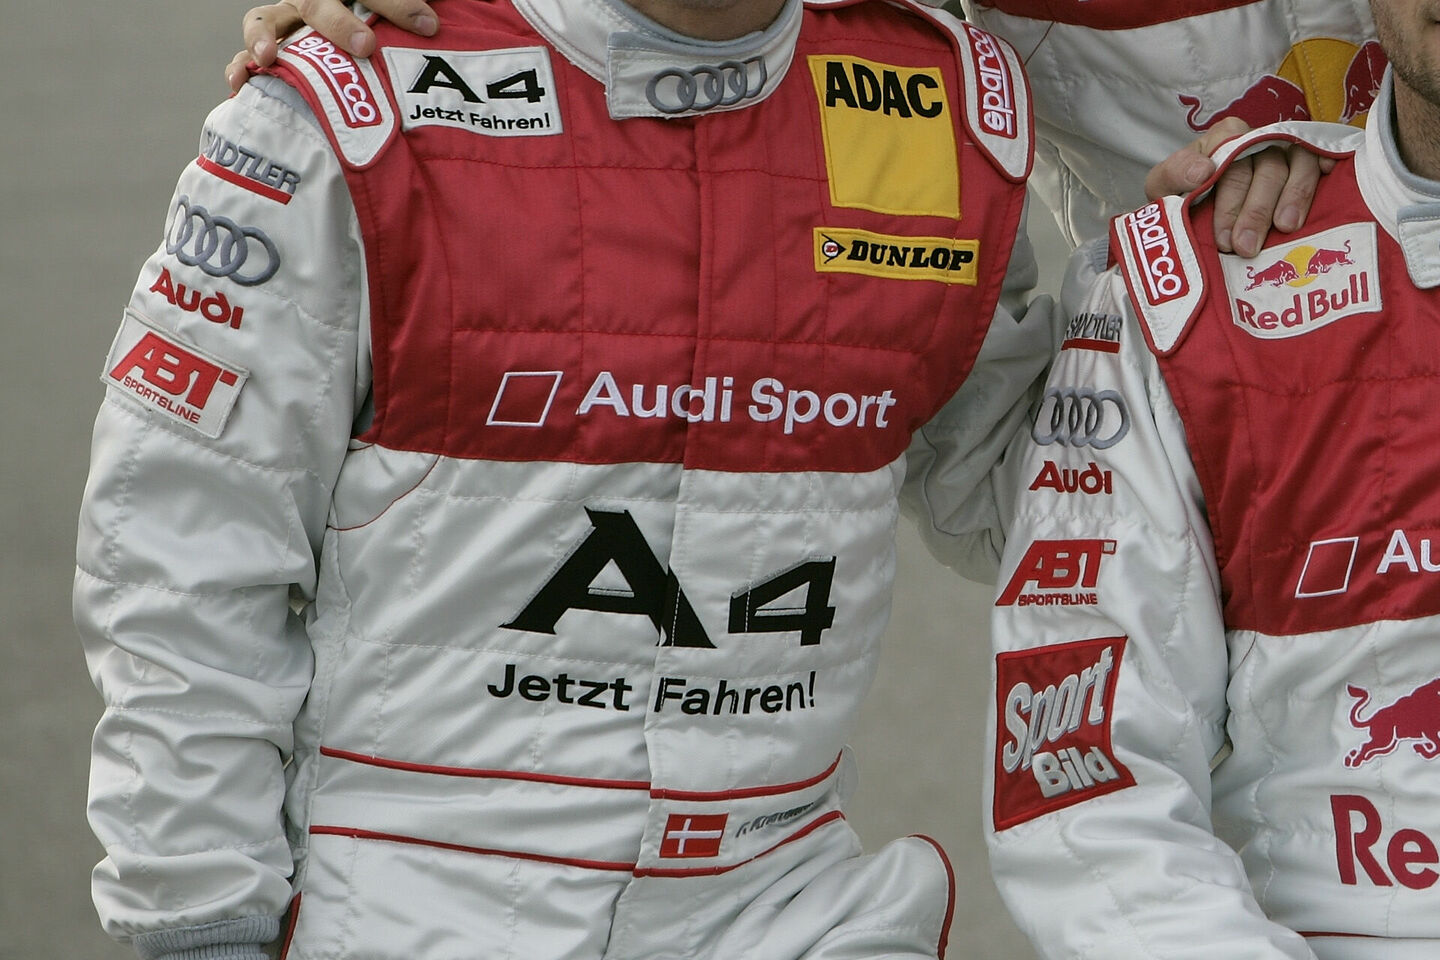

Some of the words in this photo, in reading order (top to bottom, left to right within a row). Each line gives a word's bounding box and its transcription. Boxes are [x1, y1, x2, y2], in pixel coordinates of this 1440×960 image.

[298, 36, 376, 123] sparco
[406, 55, 545, 104] A4
[826, 61, 943, 118] ADAC
[969, 27, 1013, 131] sparco
[410, 105, 465, 122] Jetzt
[470, 113, 551, 130] Fahren!
[847, 241, 974, 271] DUNLOP
[1129, 204, 1181, 296] sparco
[150, 267, 243, 329] Audi
[1235, 290, 1301, 330] Red
[1308, 272, 1369, 321] Bull
[109, 331, 238, 410] ABT
[123, 376, 201, 424] SPORTSLINE
[577, 370, 732, 423] Audi
[748, 378, 896, 433] Sport
[1029, 461, 1112, 494] Audi
[498, 506, 837, 649] A4
[995, 540, 1117, 606] ABT
[1018, 593, 1098, 606] SPORTSLINE
[488, 665, 632, 712] Jetzt
[654, 671, 816, 715] Fahren!
[1002, 647, 1113, 774] Sport
[1030, 745, 1116, 800] Bild
